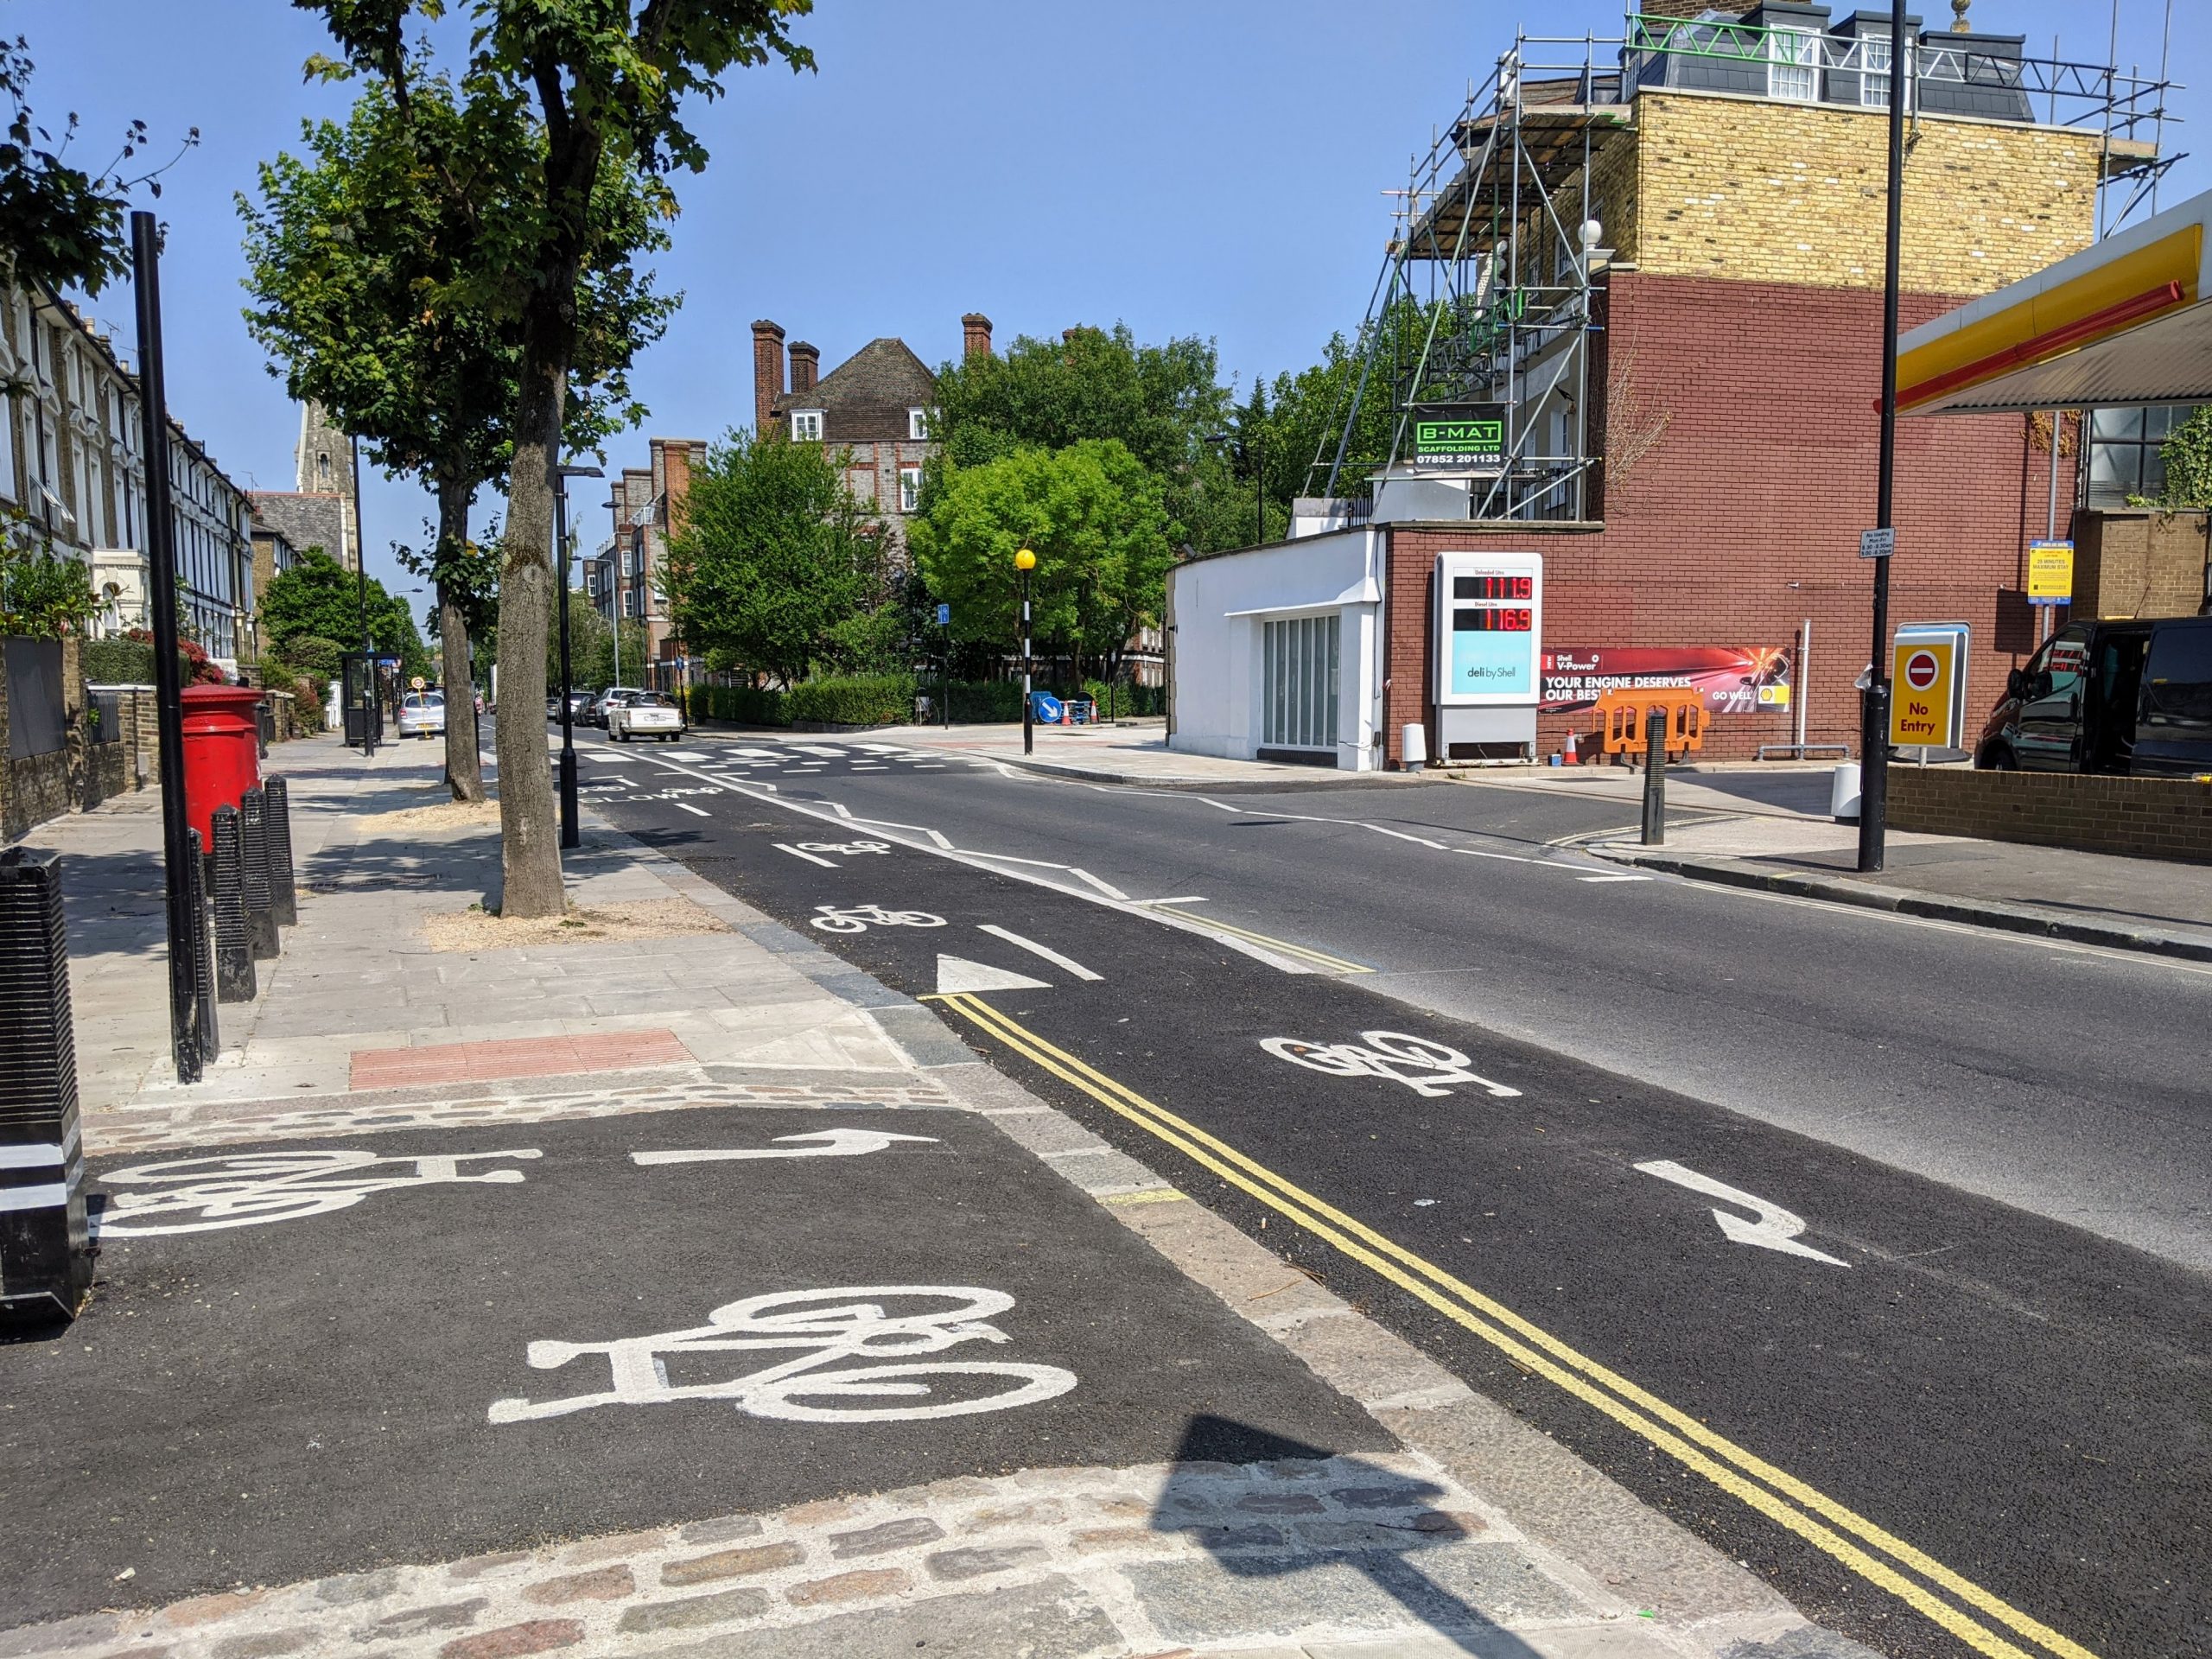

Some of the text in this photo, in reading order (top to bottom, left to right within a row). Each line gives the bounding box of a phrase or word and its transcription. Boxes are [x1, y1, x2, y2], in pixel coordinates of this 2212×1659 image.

[1423, 427, 1497, 439] B-MAT
[1416, 454, 1501, 463] 07852 201133
[1486, 577, 1532, 598] 111.9
[1486, 609, 1531, 630] 116.9
[1556, 662, 1597, 671] V-Power
[1467, 667, 1516, 680] deli by Shell
[1545, 677, 1692, 689] YOUR ENGINE DESERVES
[1545, 689, 1573, 701] OUR
[1713, 691, 1752, 700] GO WELL
[1909, 702, 1929, 715] No
[1901, 718, 1936, 736] Entry
